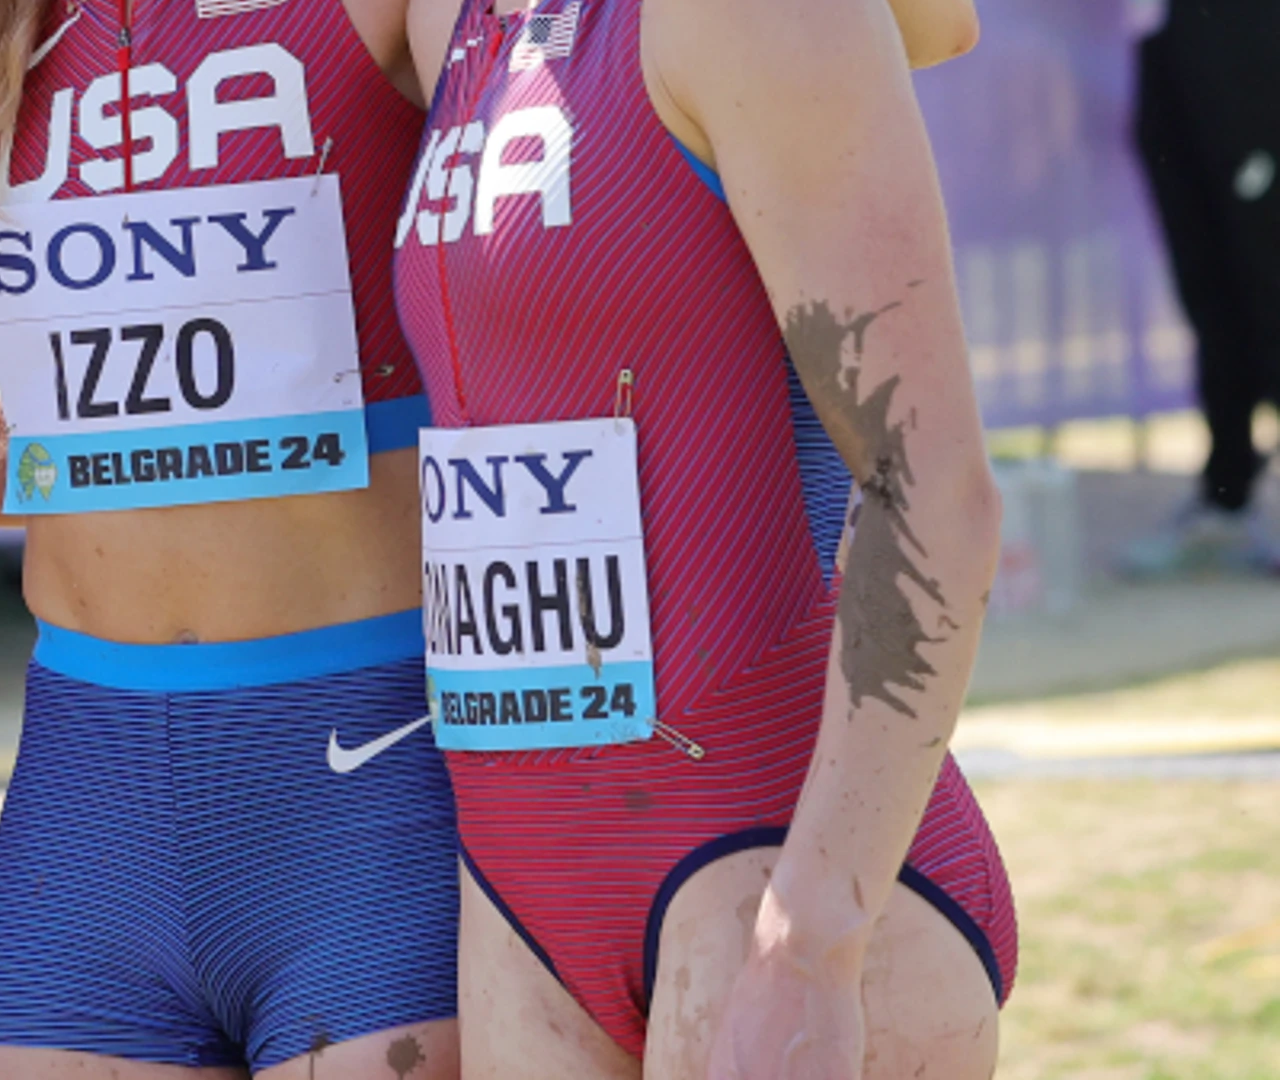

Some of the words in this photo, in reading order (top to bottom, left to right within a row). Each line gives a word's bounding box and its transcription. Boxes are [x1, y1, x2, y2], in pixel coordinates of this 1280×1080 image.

[48, 317, 236, 421] IZZO
[67, 439, 272, 489] BELGRADE
[279, 433, 345, 470] 24
[421, 448, 594, 523] ONY
[580, 683, 637, 719] 24
